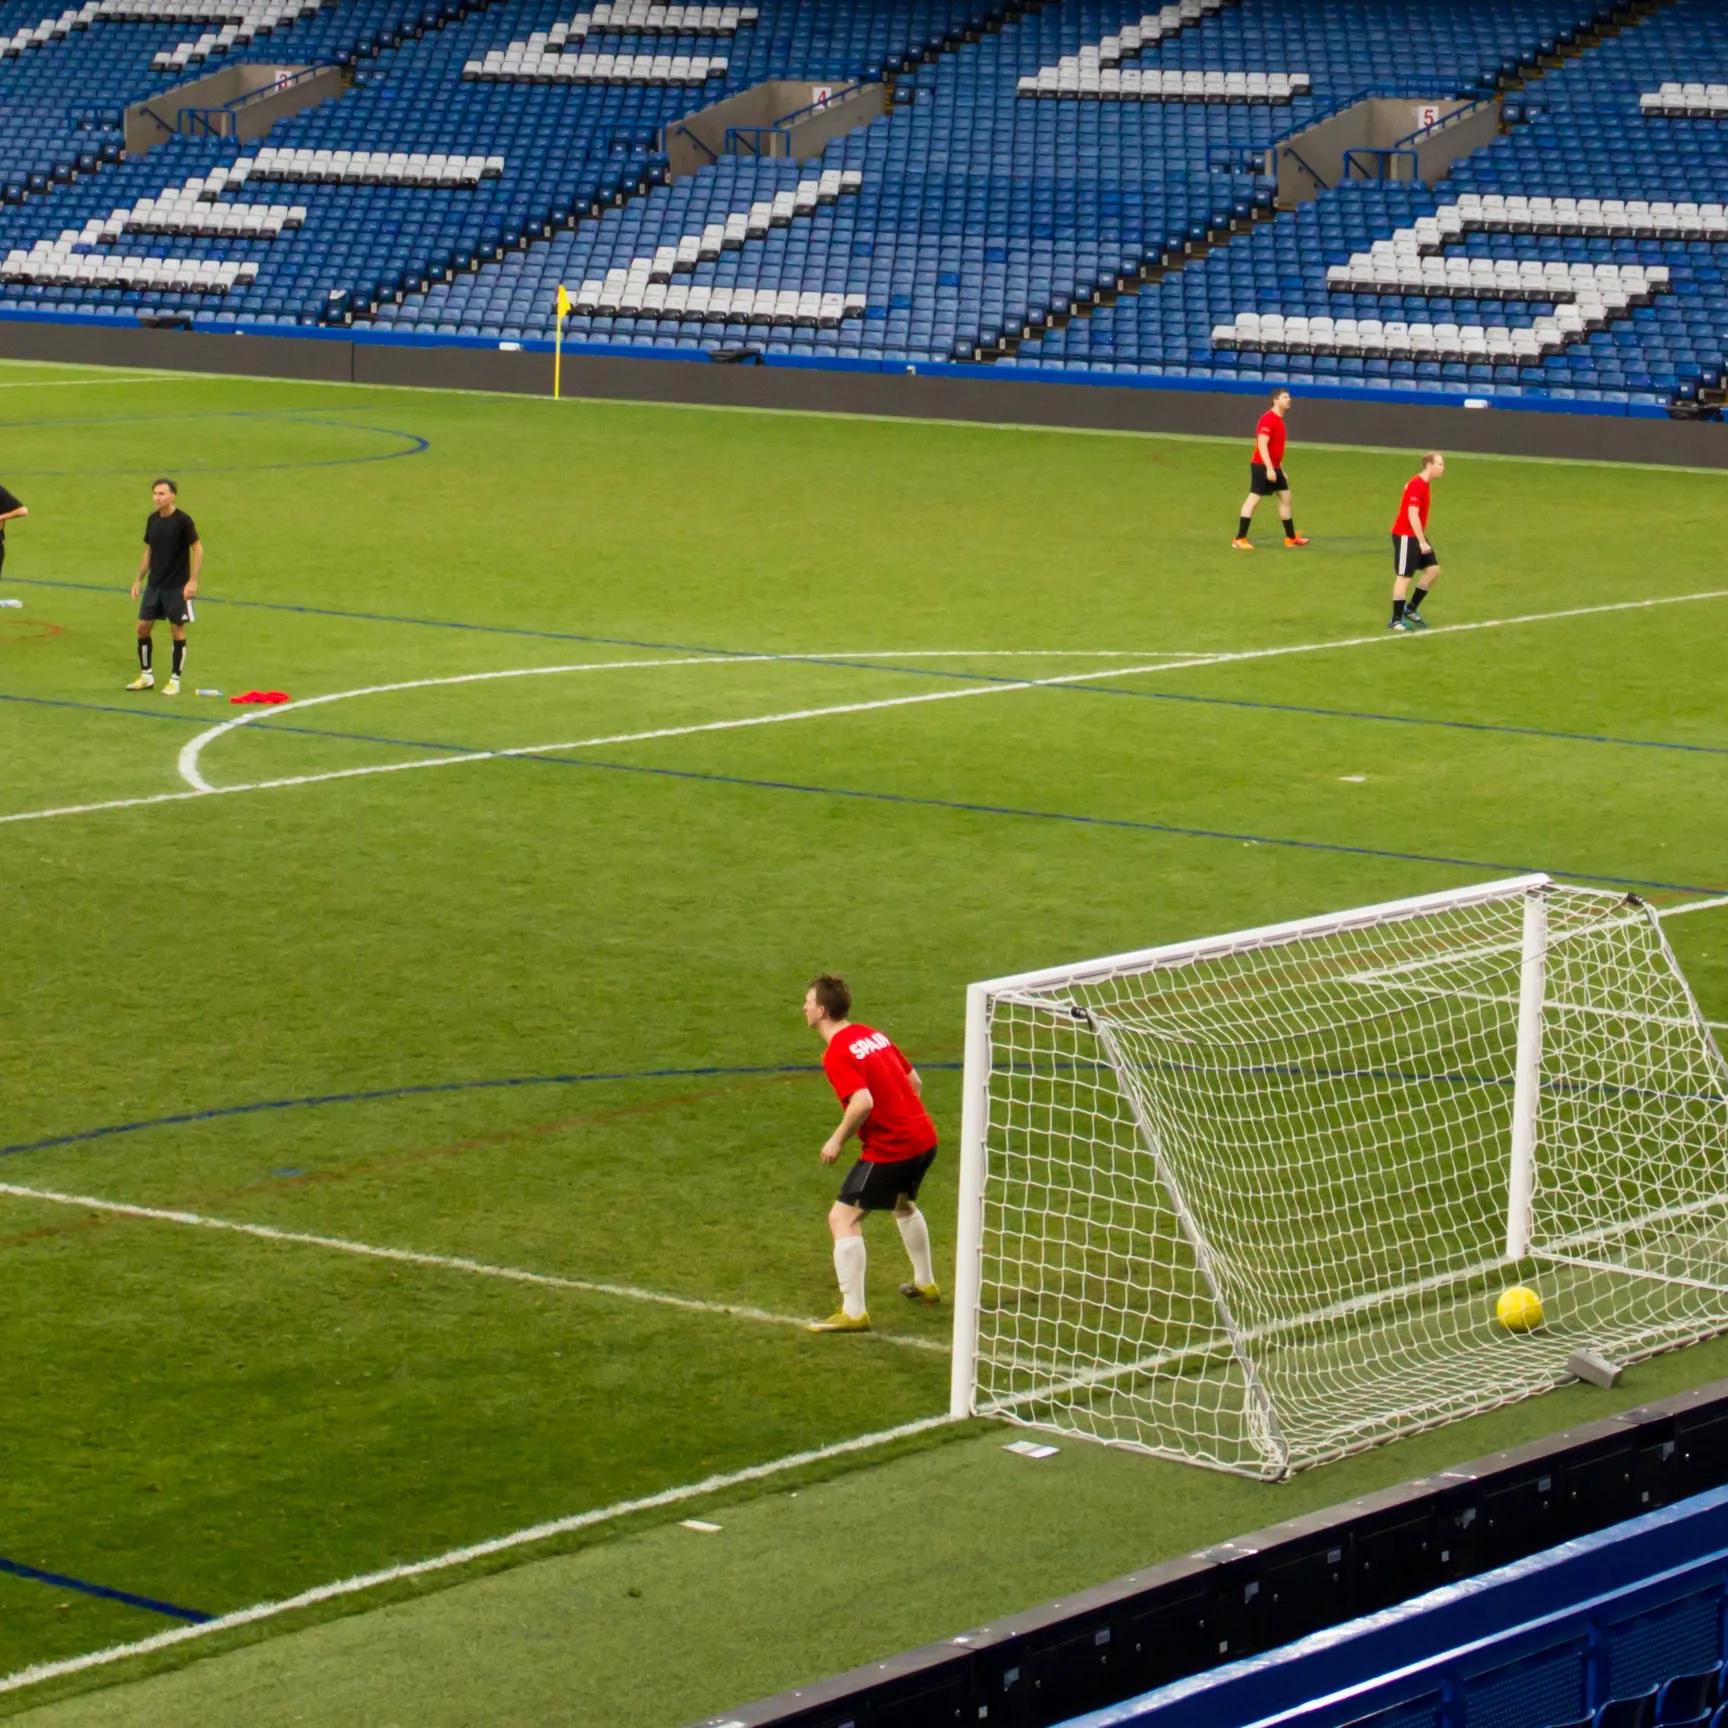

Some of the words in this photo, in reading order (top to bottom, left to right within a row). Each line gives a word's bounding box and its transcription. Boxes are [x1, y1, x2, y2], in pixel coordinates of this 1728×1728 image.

[818, 90, 827, 106] 4
[1424, 109, 1434, 127] 5
[849, 1031, 891, 1060] SPAIN
